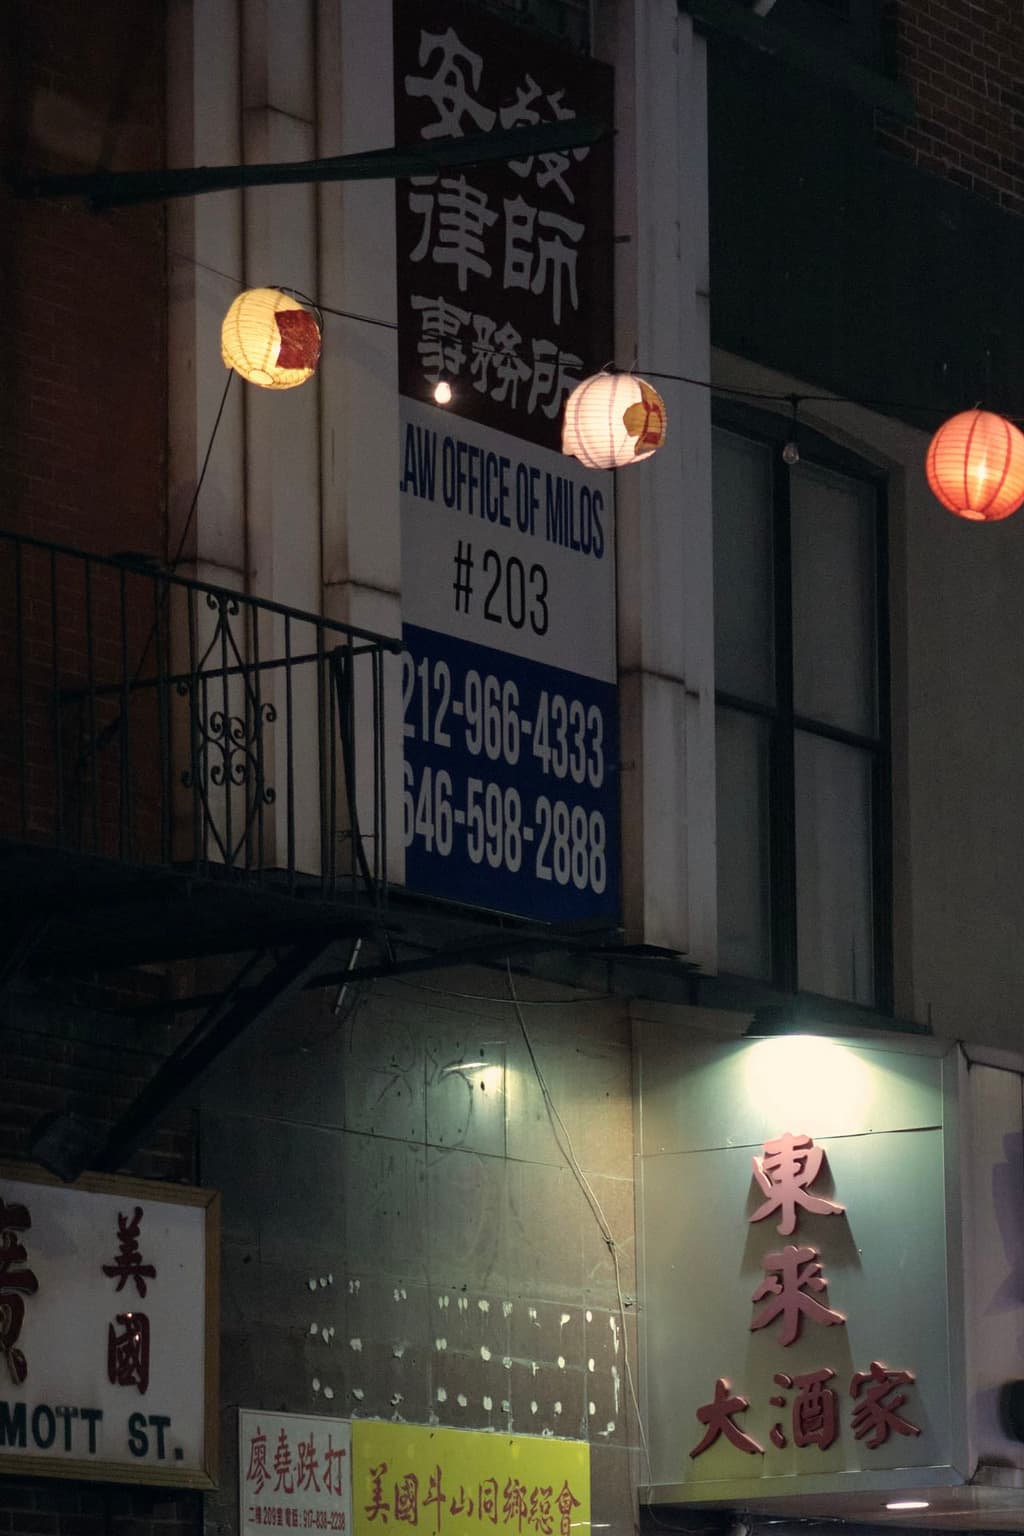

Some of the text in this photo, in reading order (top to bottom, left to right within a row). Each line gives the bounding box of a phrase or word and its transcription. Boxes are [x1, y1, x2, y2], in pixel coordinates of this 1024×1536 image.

[408, 174, 586, 326] 律師
[411, 294, 585, 419] 事務所
[400, 423, 604, 560] AW OFFICE OF MILOS
[454, 540, 549, 636] #203
[402, 650, 604, 788] 212-966-4333
[102, 1206, 156, 1395] 美國
[1, 1402, 184, 1460] MOTT ST.
[690, 1361, 922, 1459] 大酒家
